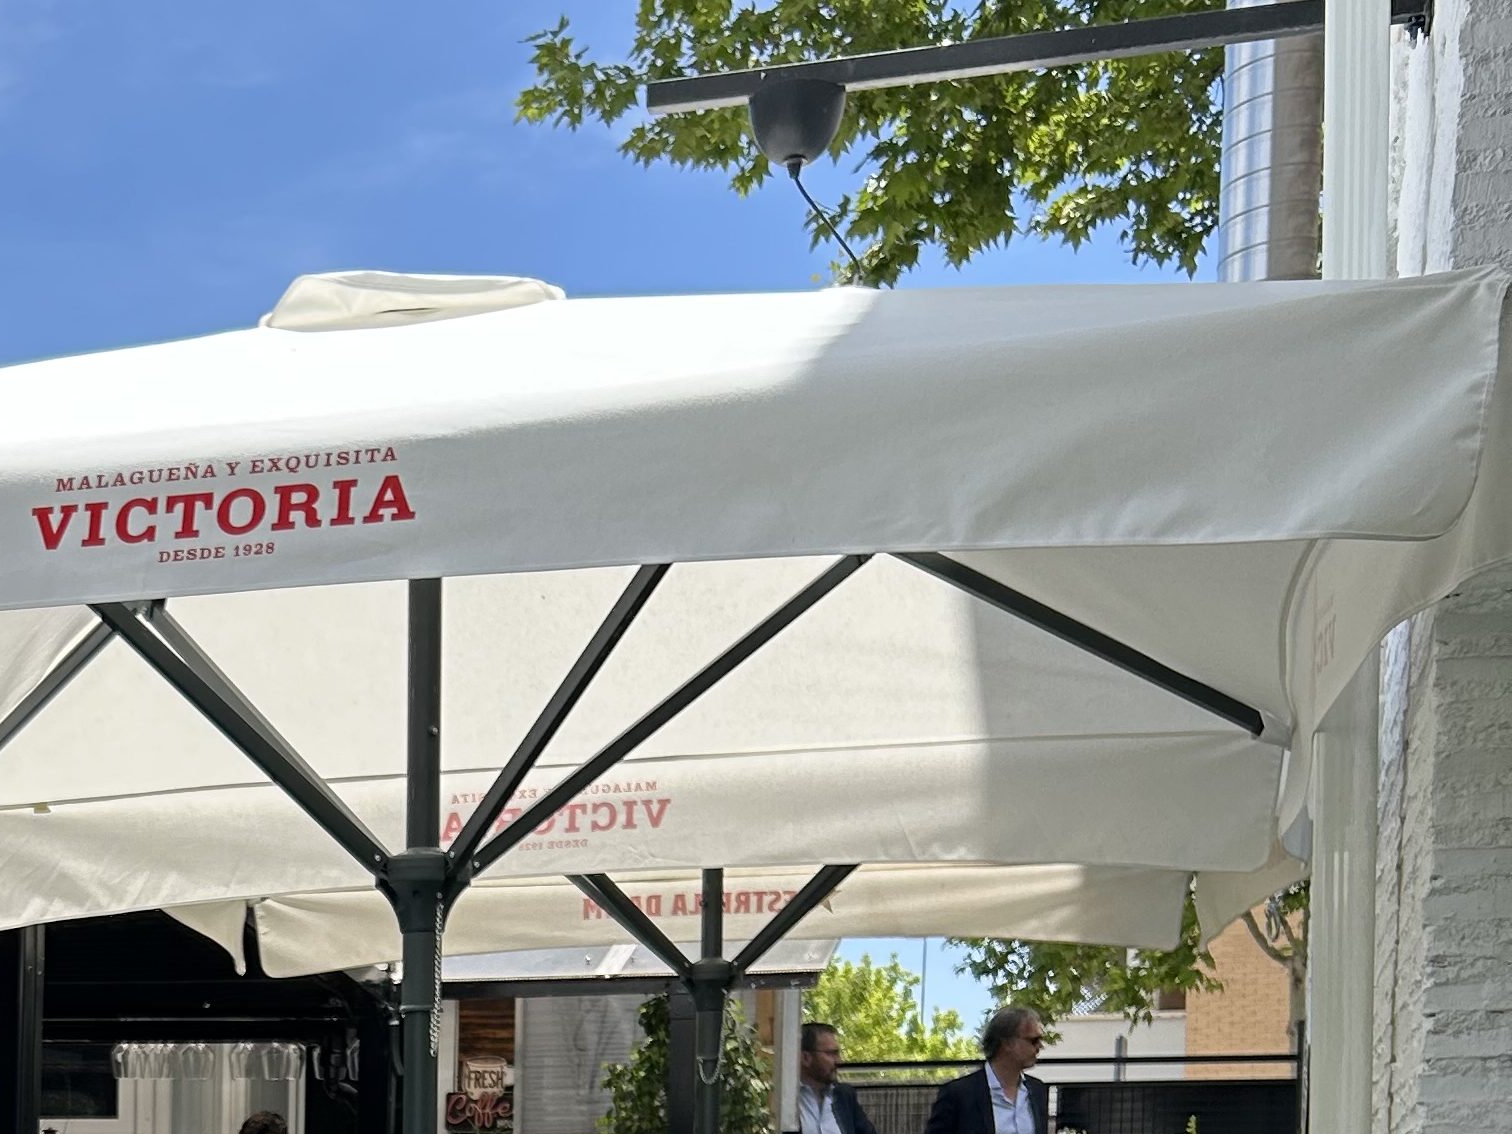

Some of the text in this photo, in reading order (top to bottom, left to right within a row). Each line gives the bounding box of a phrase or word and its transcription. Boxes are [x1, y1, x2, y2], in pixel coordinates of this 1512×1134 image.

[55, 446, 398, 492] MALAGUEÑA Y EXQUISITA
[31, 474, 416, 551] VICTORIA
[158, 542, 275, 563] DESDE 1928
[468, 1070, 505, 1089] FRESH
